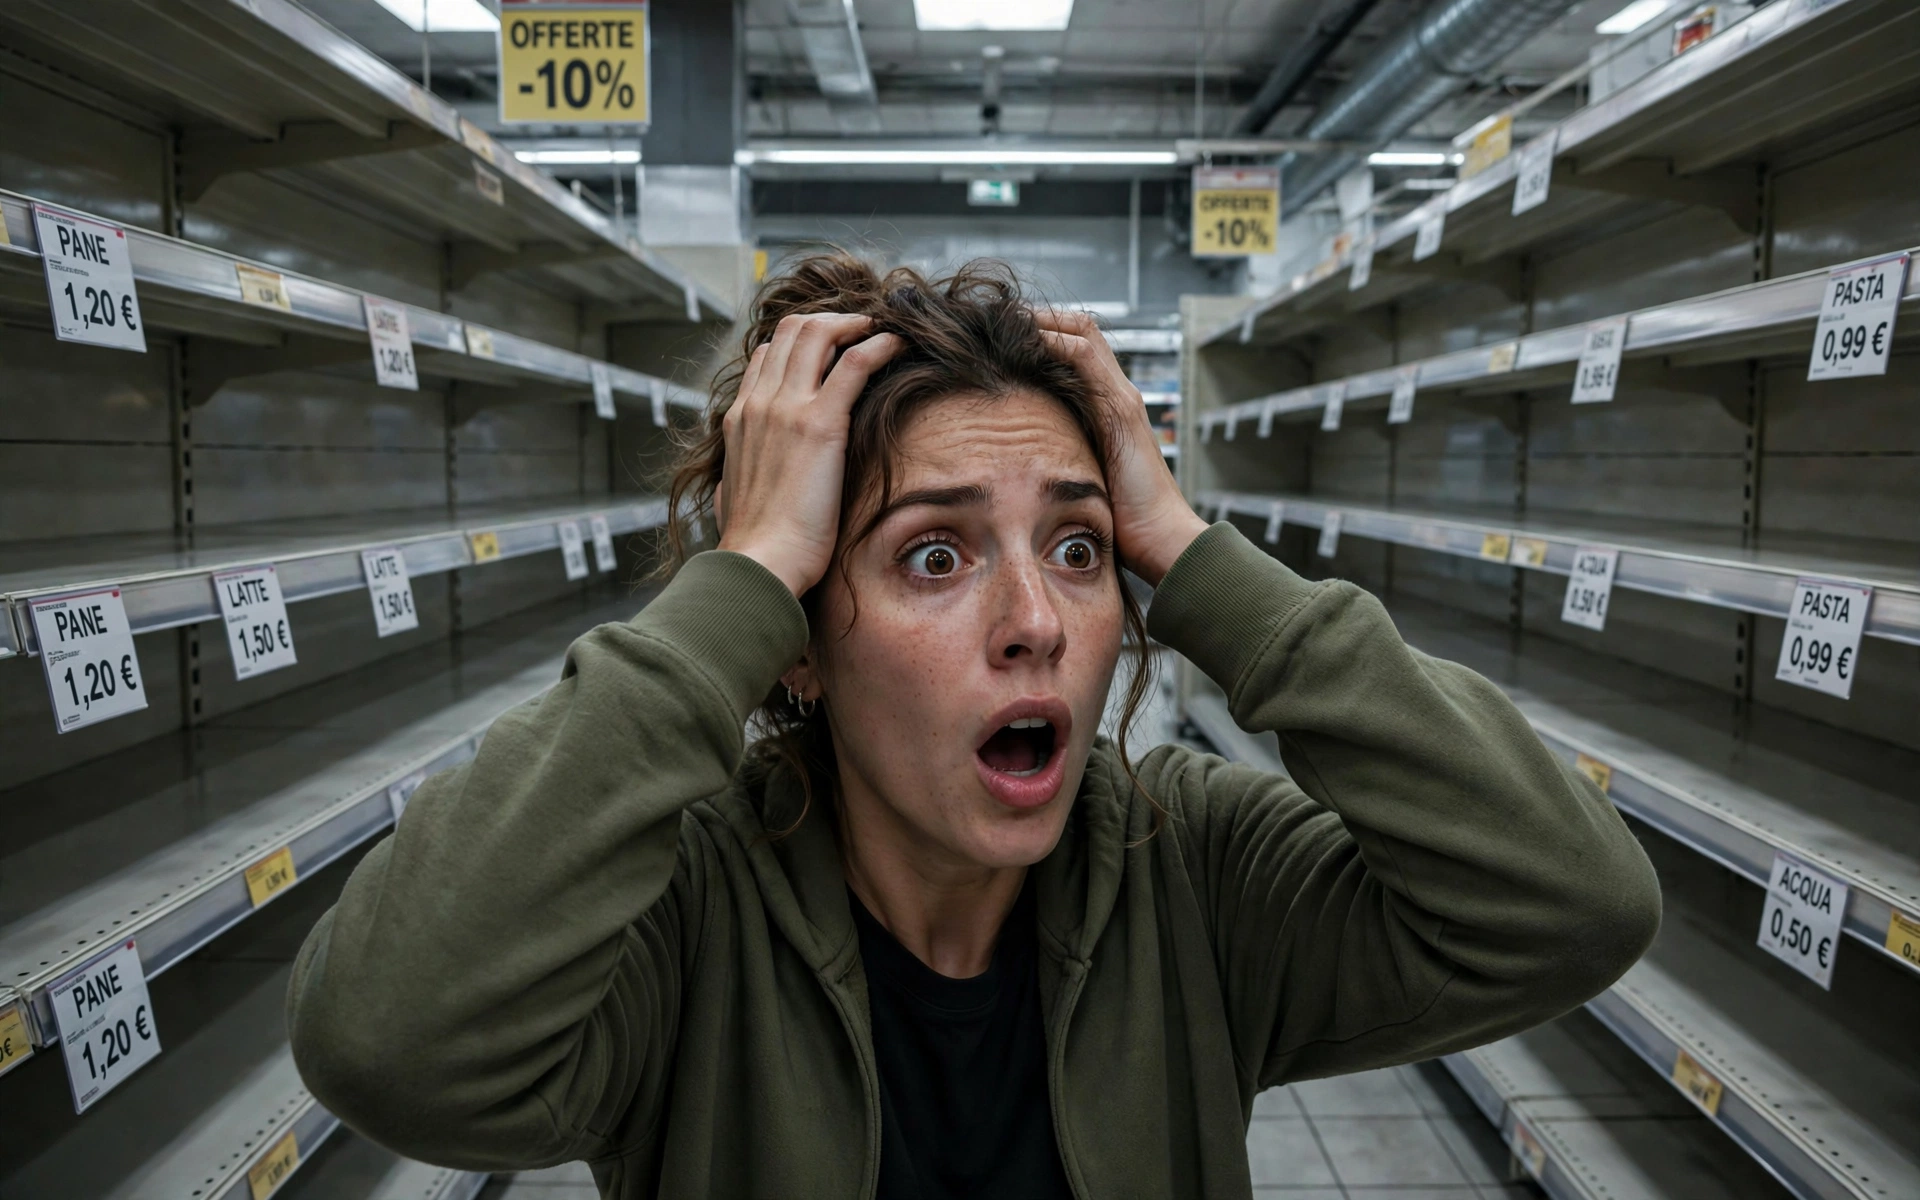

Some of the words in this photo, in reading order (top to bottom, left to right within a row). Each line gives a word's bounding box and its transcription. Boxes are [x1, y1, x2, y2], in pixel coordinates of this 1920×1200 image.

[511, 20, 634, 48] OFFERTE
[519, 58, 635, 110] -10%
[56, 224, 110, 266] PANE
[1204, 218, 1269, 247] -10%
[64, 282, 116, 330] 1,20
[121, 294, 137, 331] €
[1832, 273, 1884, 307] PASTA
[1822, 325, 1866, 366] 0,99
[1872, 321, 1888, 355] €
[369, 556, 399, 579] LATTE
[227, 578, 270, 608] LATTE
[379, 593, 403, 623] 1,50
[1800, 591, 1850, 623] PASTA
[54, 605, 108, 642] PANE
[238, 623, 274, 663] 1,50
[277, 619, 289, 649] €
[1790, 636, 1832, 674] 0,99
[1837, 646, 1853, 680] €
[64, 659, 116, 711] 1,20
[120, 654, 137, 690] €
[1779, 866, 1831, 914] ACQUA
[1770, 908, 1812, 956] 0,50
[1817, 937, 1832, 969] €
[72, 964, 122, 1018] PANE
[83, 1019, 131, 1080] 1,20
[135, 1005, 151, 1041] €
